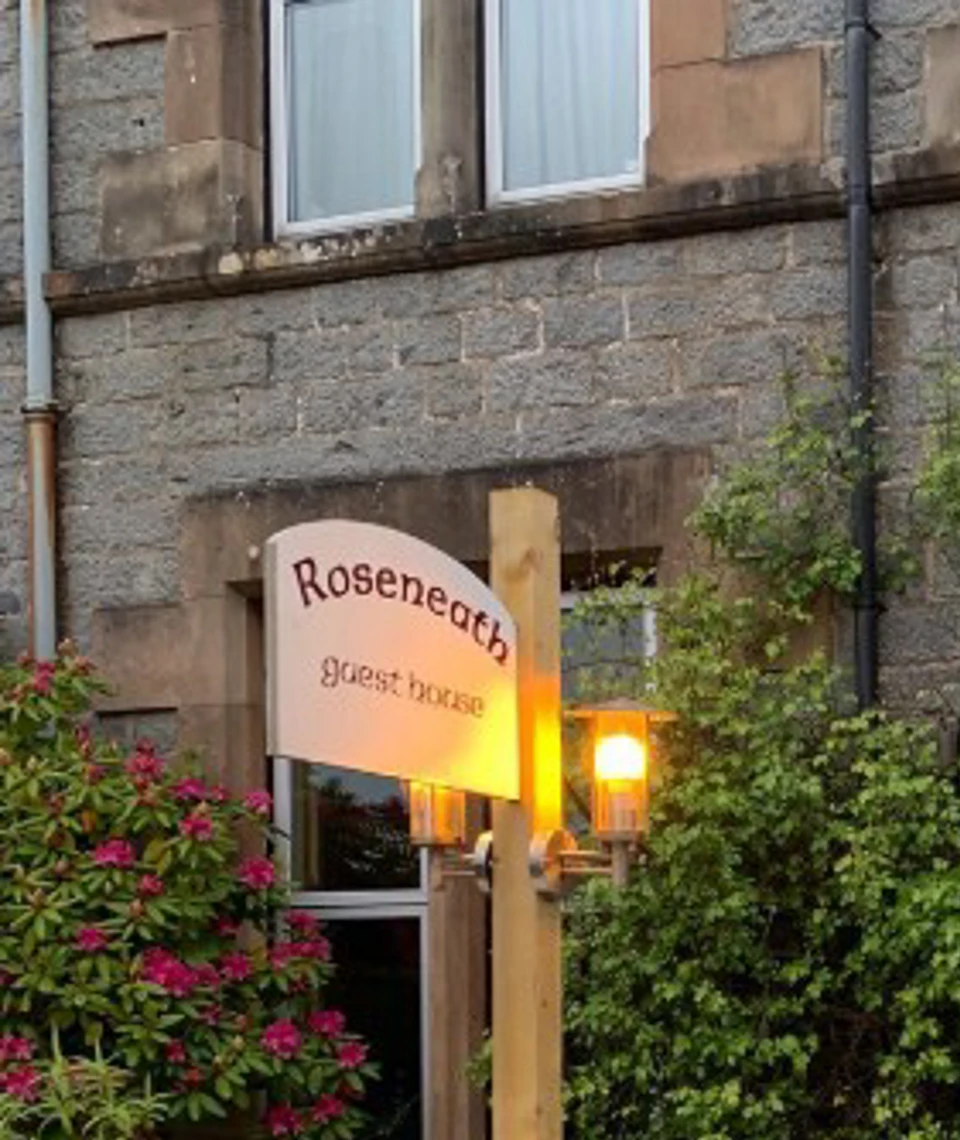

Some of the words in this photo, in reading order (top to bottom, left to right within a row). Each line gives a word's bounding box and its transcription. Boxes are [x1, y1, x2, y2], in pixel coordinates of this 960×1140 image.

[292, 557, 511, 667] Roseneath
[320, 656, 402, 695] guest
[409, 671, 485, 718] house
